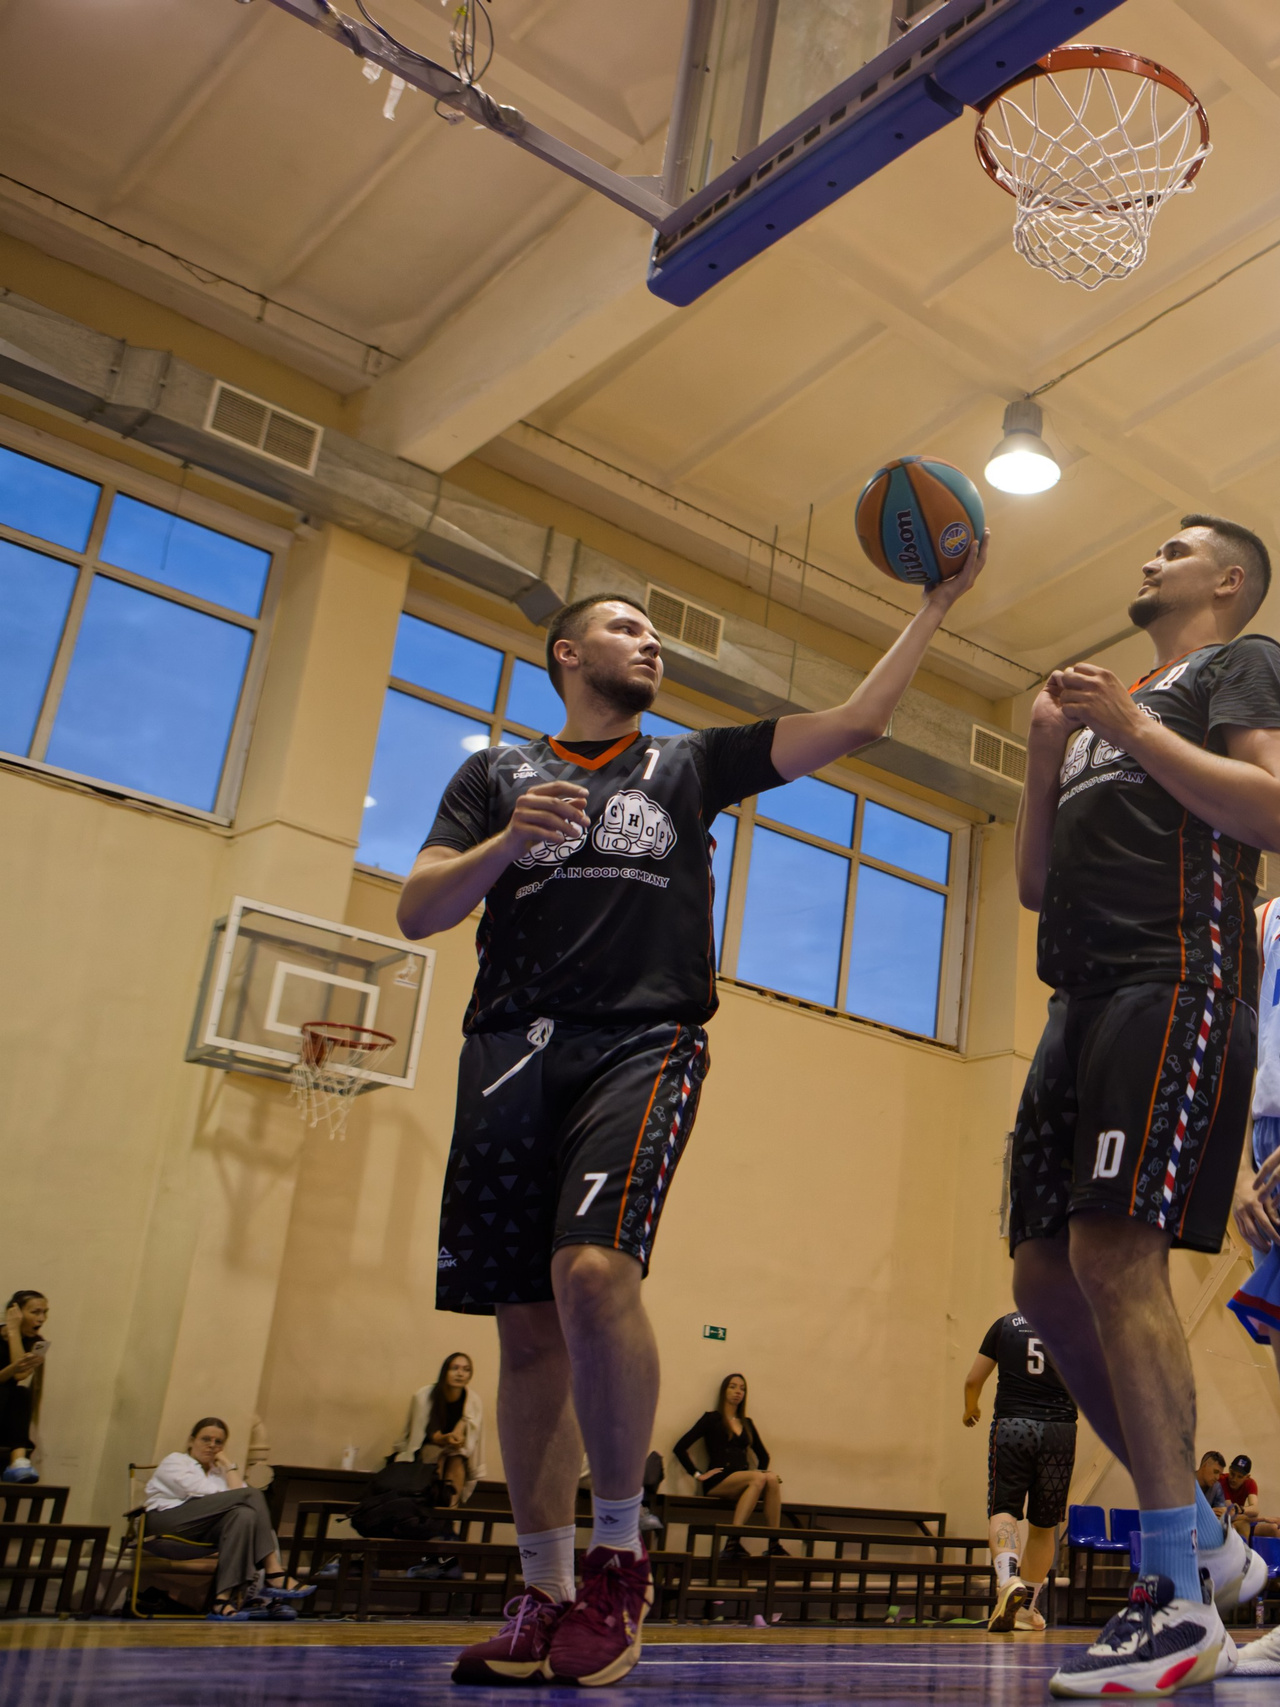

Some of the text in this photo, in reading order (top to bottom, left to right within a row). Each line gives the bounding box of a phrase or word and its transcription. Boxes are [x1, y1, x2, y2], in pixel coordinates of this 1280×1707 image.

[513, 771, 538, 780] PEAK
[567, 867, 582, 878] IN
[583, 867, 619, 878] GOOD
[620, 868, 670, 888] COMPANY
[1092, 1130, 1126, 1180] 10
[576, 1172, 609, 1217] 7
[1012, 1316, 1028, 1327] CH
[1027, 1337, 1045, 1375] 5
